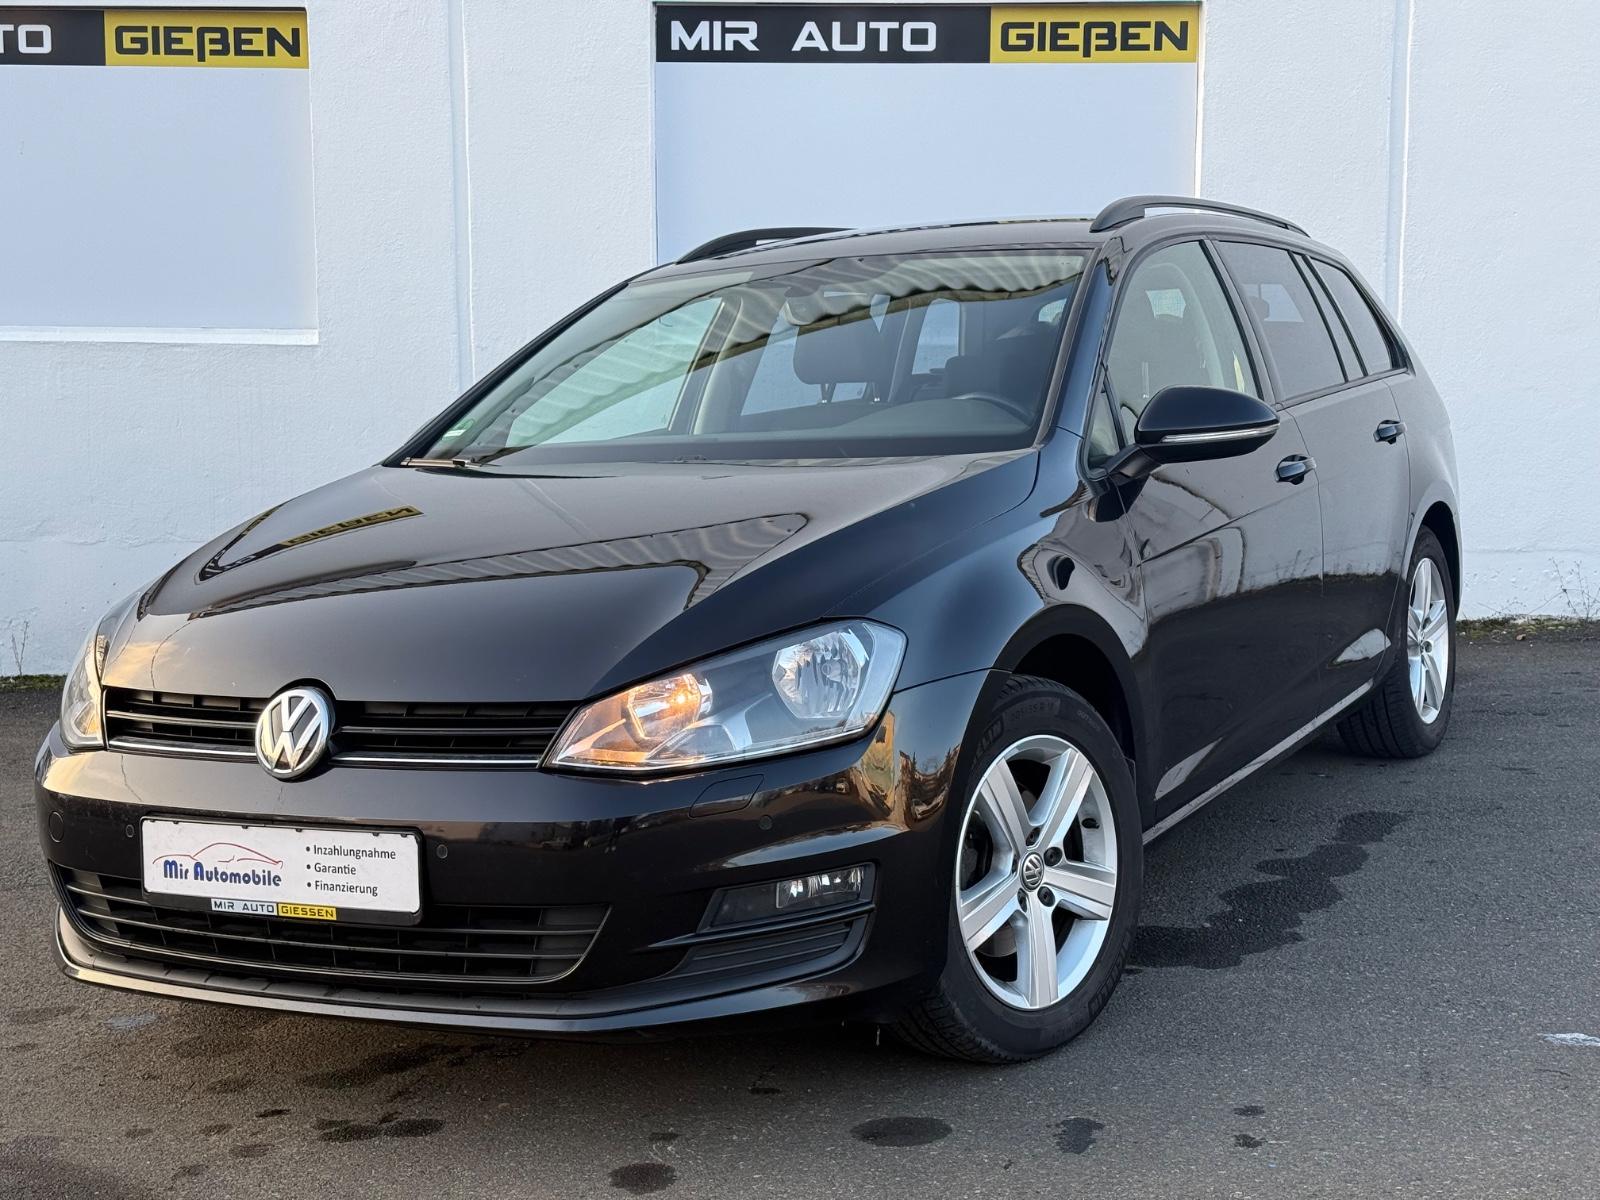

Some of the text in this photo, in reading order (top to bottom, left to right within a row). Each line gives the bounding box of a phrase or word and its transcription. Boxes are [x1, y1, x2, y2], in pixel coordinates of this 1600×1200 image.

[670, 20, 759, 51] MIR
[791, 21, 937, 52] AUTO
[313, 845, 396, 860] Inzahlungnahme
[163, 859, 282, 887] Mir Automobile
[314, 863, 356, 876] Garantie
[315, 880, 378, 896] Finanzierung
[214, 900, 334, 919] MIR AUTO GIESSEN
